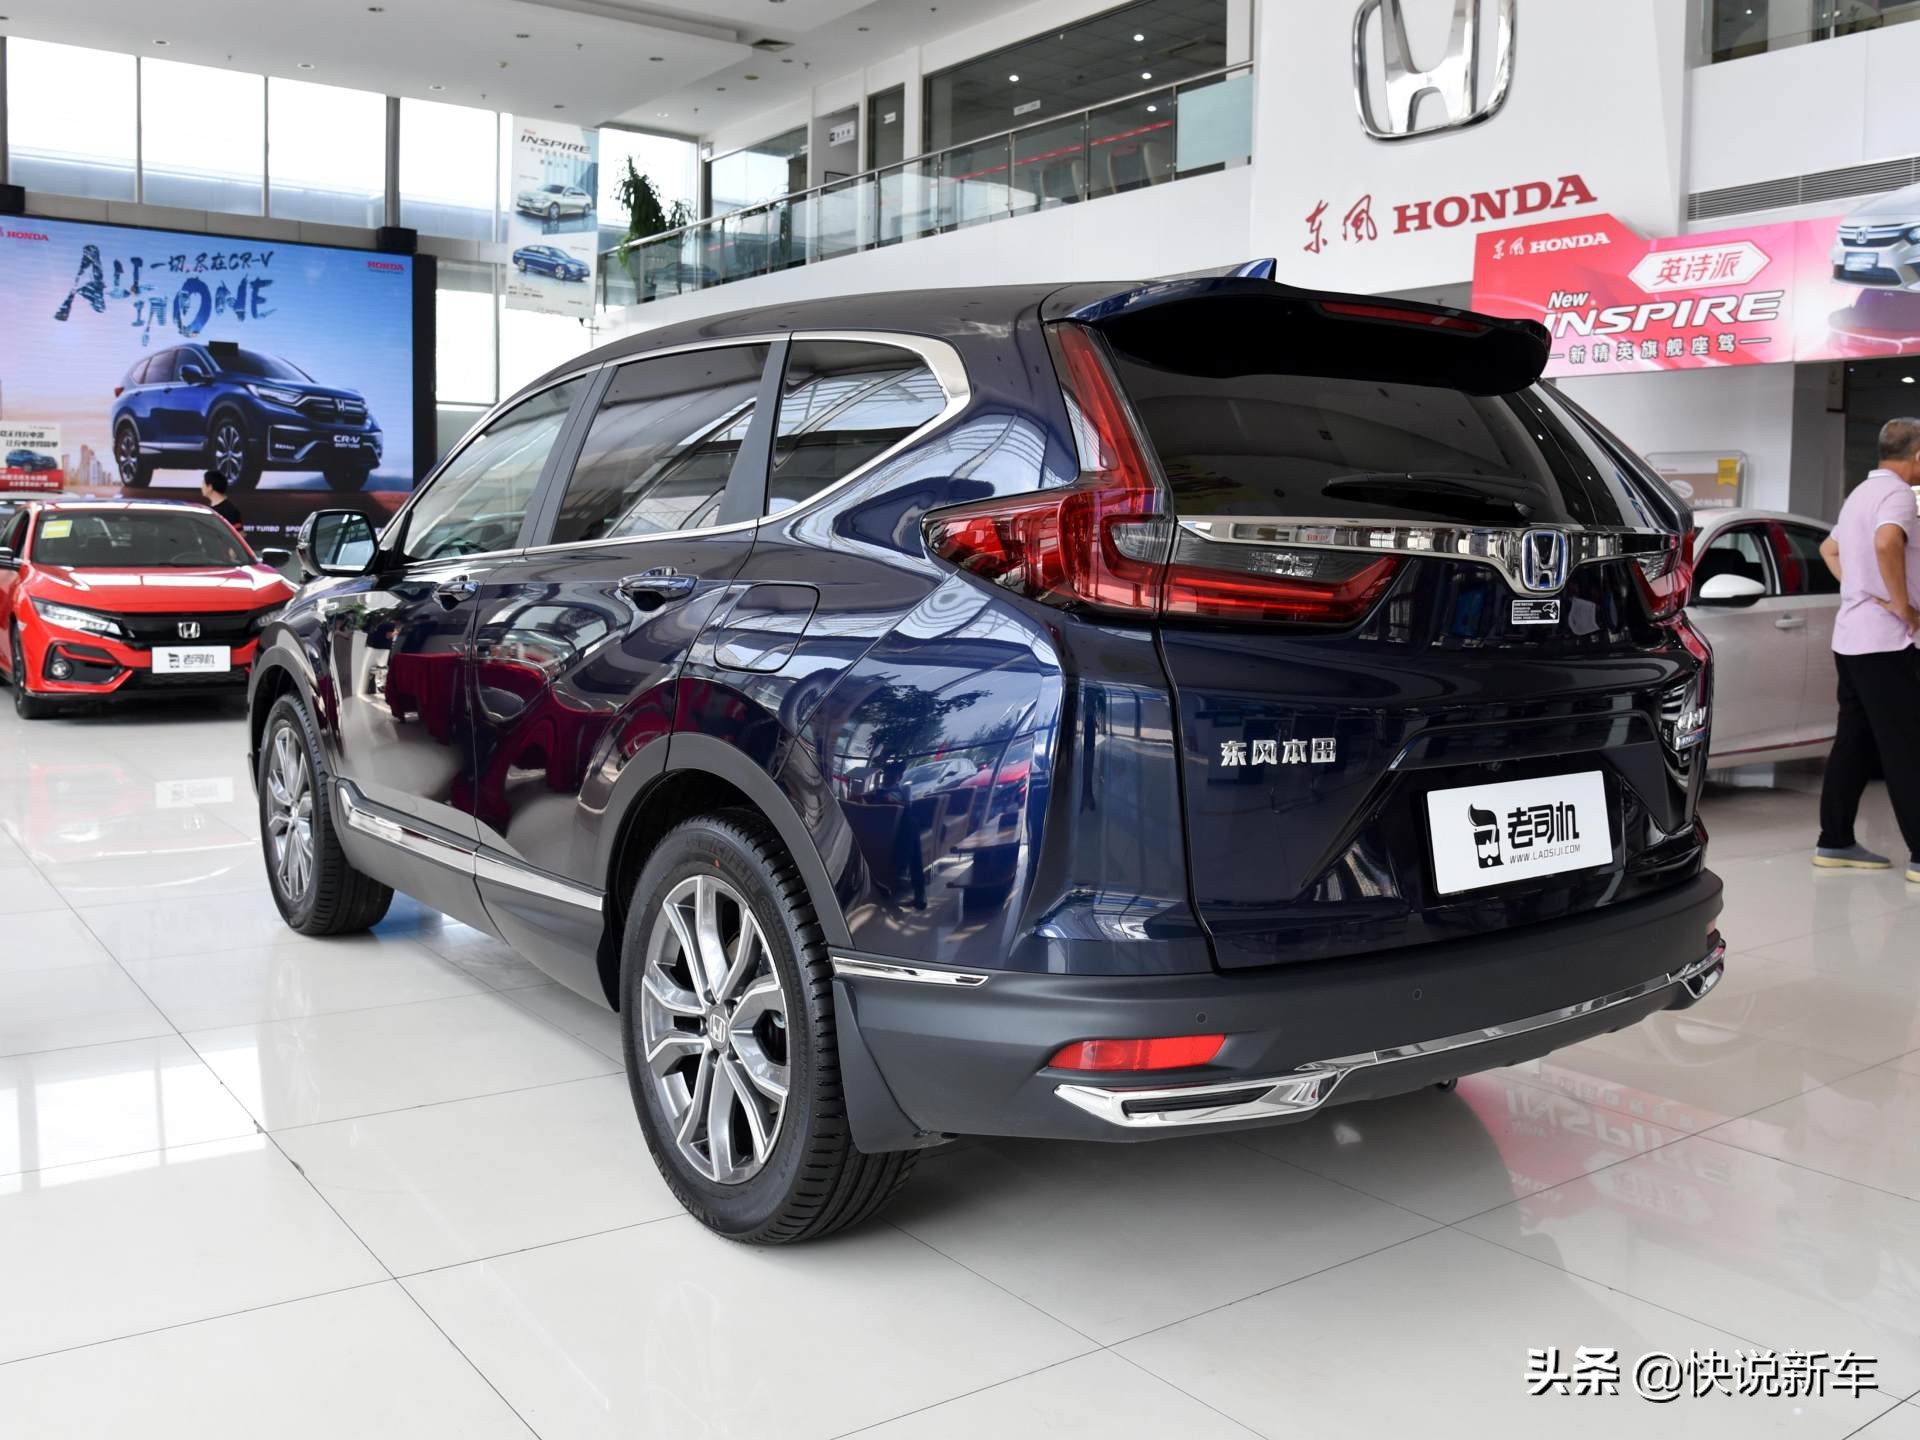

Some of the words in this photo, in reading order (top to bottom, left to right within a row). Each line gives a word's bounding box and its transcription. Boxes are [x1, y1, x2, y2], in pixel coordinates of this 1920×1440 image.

[520, 134, 592, 154] INSPIRE
[1393, 174, 1597, 234] HONDA
[1529, 232, 1611, 254] HONDA
[1653, 251, 1744, 286] 英诗派
[1541, 290, 1785, 338] INSPIRE
[1547, 290, 1589, 309] New
[1568, 333, 1737, 365] 新精英旗舰座驾
[1220, 738, 1337, 767] 东风本田
[1507, 801, 1580, 849] 老司机
[1509, 844, 1581, 864] WWW.LAOSIJI.COM
